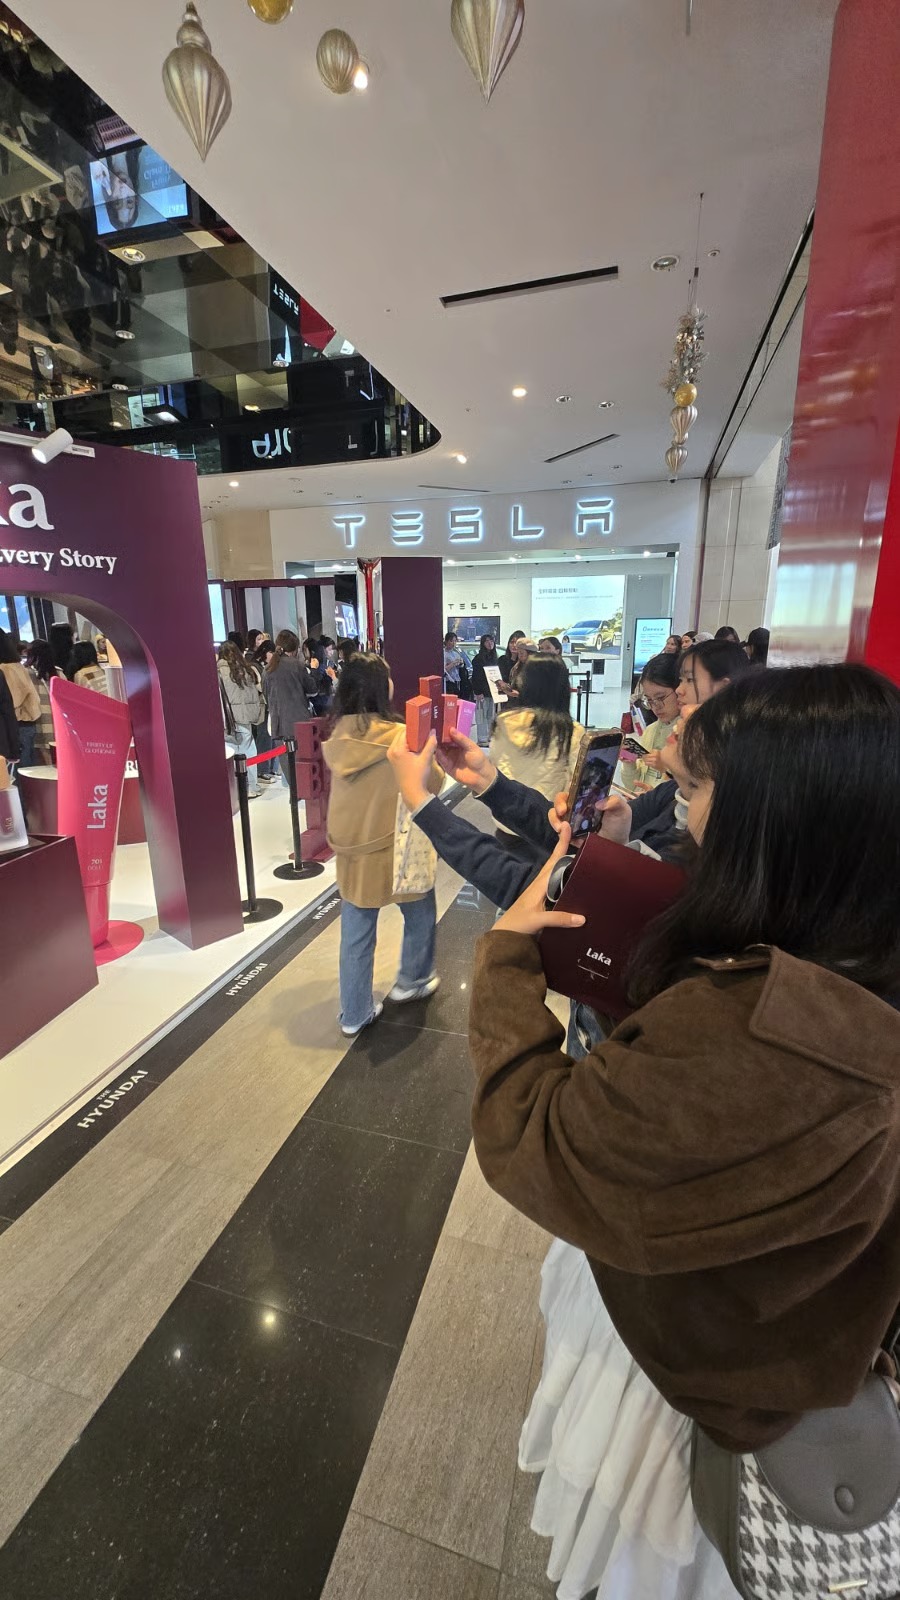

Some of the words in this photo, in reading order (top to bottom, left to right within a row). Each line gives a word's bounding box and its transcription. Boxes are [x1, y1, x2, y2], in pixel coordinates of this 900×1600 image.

[0, 482, 55, 531] a
[332, 498, 614, 548] TESLA
[59, 547, 118, 575] Story
[447, 602, 501, 610] TESLA
[86, 784, 108, 829] Laka
[586, 947, 612, 966] Laka
[225, 962, 269, 996] HYUNDAI
[76, 1069, 149, 1129] HYUNDAI
[96, 1089, 111, 1101] THE
